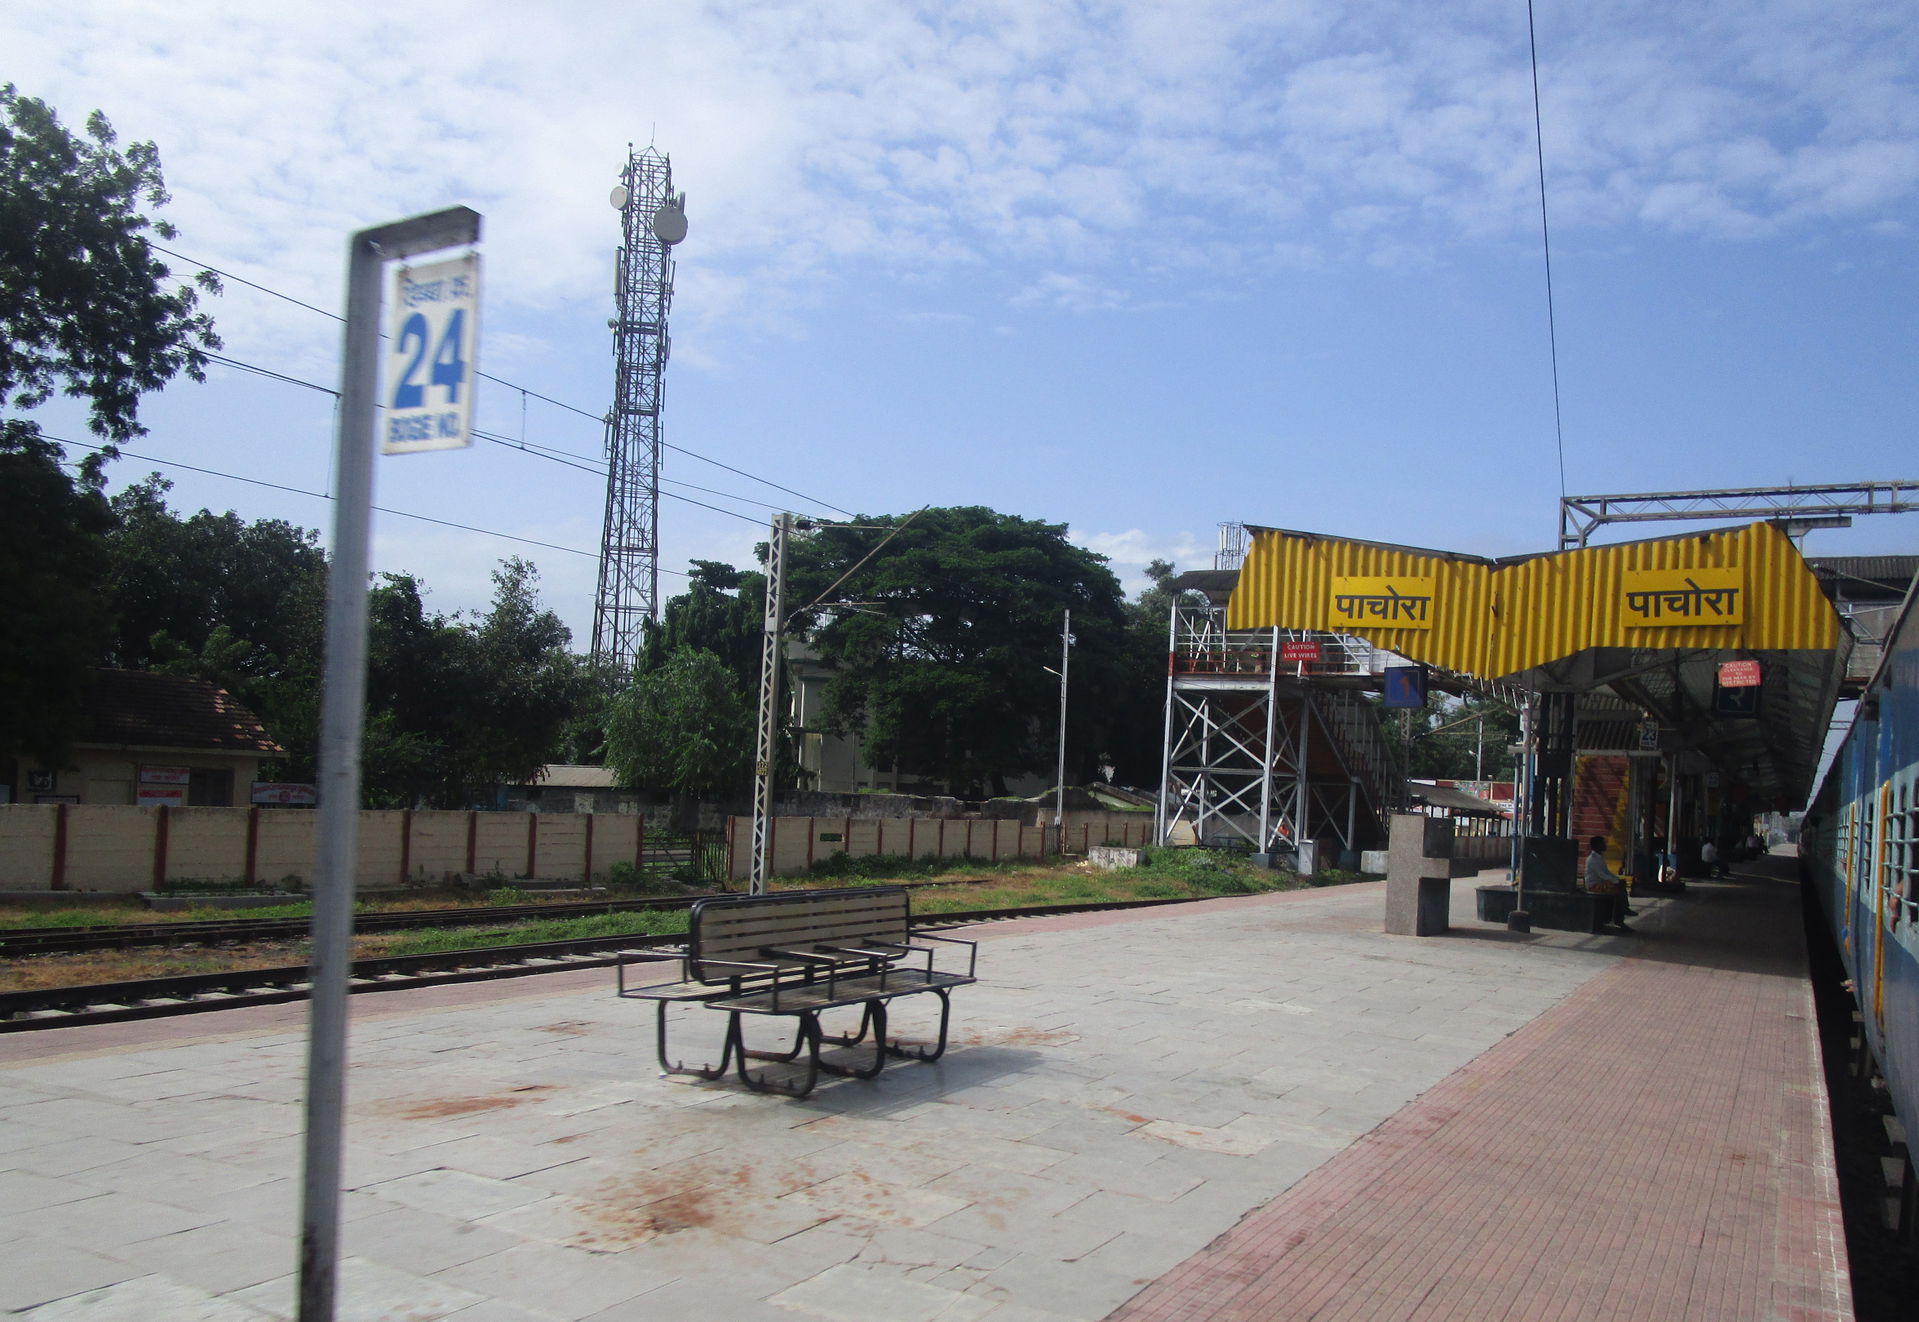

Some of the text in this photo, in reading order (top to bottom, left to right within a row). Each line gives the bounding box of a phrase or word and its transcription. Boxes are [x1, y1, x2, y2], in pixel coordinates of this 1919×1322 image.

[393, 308, 466, 409] 24
[1335, 584, 1431, 621] पाचोरा
[1625, 577, 1739, 618] पाचोरा
[1399, 675, 1410, 698] 1
